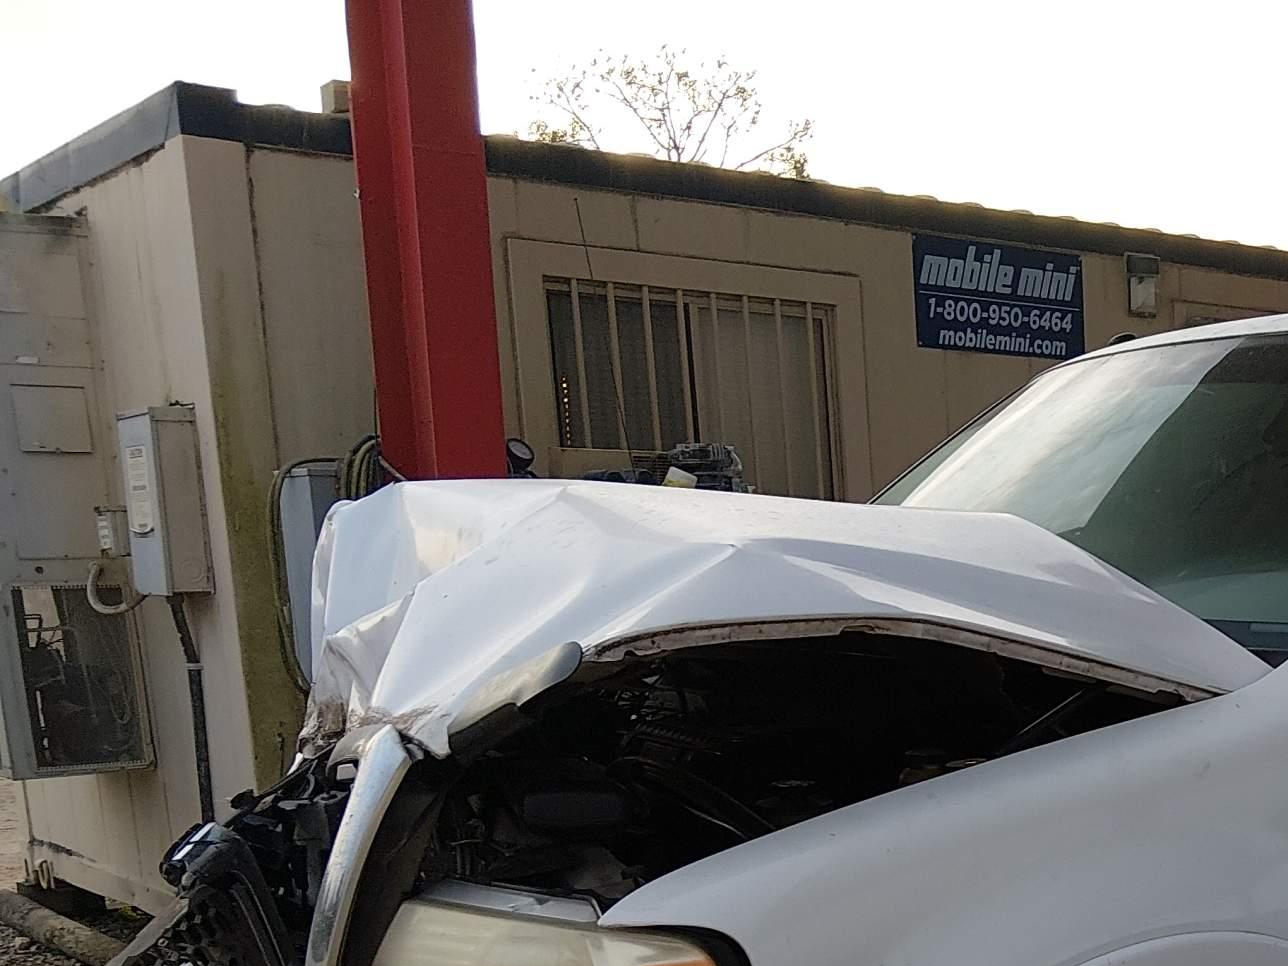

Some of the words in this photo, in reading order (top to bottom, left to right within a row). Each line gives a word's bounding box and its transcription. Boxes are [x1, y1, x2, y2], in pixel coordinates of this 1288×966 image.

[920, 246, 1014, 294] mobile
[1017, 262, 1078, 301] mini
[928, 298, 1073, 333] 1-800-950-6464
[938, 328, 1066, 356] mobilemini.com
